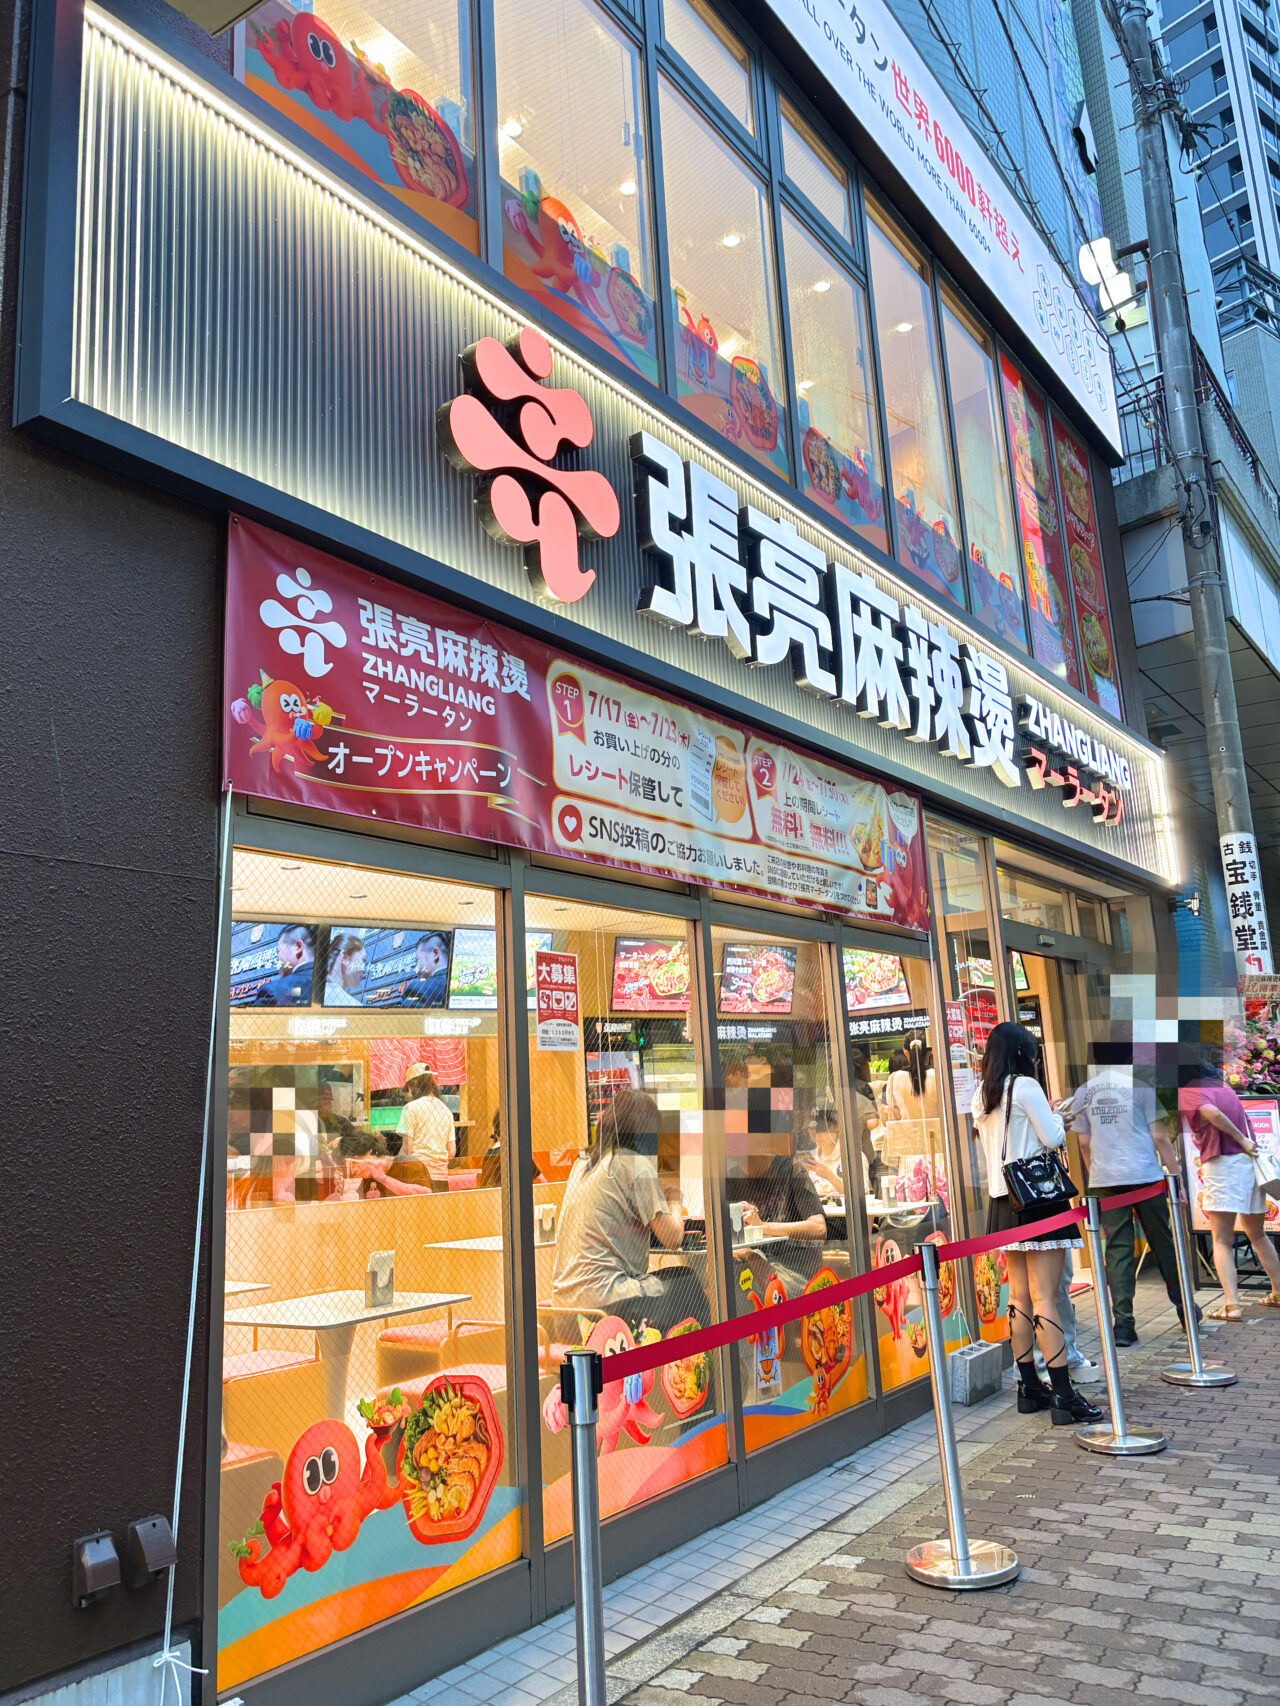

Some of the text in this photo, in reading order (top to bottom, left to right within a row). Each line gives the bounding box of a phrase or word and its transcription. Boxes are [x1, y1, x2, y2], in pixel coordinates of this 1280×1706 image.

[823, 20, 854, 73] OVER
[855, 61, 878, 104] THE
[878, 92, 915, 153] WORLD
[916, 146, 943, 193] MORE
[943, 182, 968, 225] THAN
[634, 430, 1020, 787] 張亮麻辣燙
[357, 597, 532, 702] 張亮麻辣燙
[360, 651, 497, 716] ZHANGLIANG
[361, 680, 473, 732] マーラータン
[554, 681, 580, 700] STEP
[563, 699, 572, 721] 1
[327, 741, 512, 788] オープンキャンペーン
[593, 729, 681, 771] お買い上げの分の
[753, 755, 773, 768] STEP
[1025, 693, 1132, 790] ZHANGLIANG
[569, 753, 684, 808] レシート保管して
[759, 768, 772, 787] 2
[1027, 746, 1122, 826] マーラータン
[1225, 858, 1260, 953] 宝銭堂
[537, 961, 576, 985] 大募集
